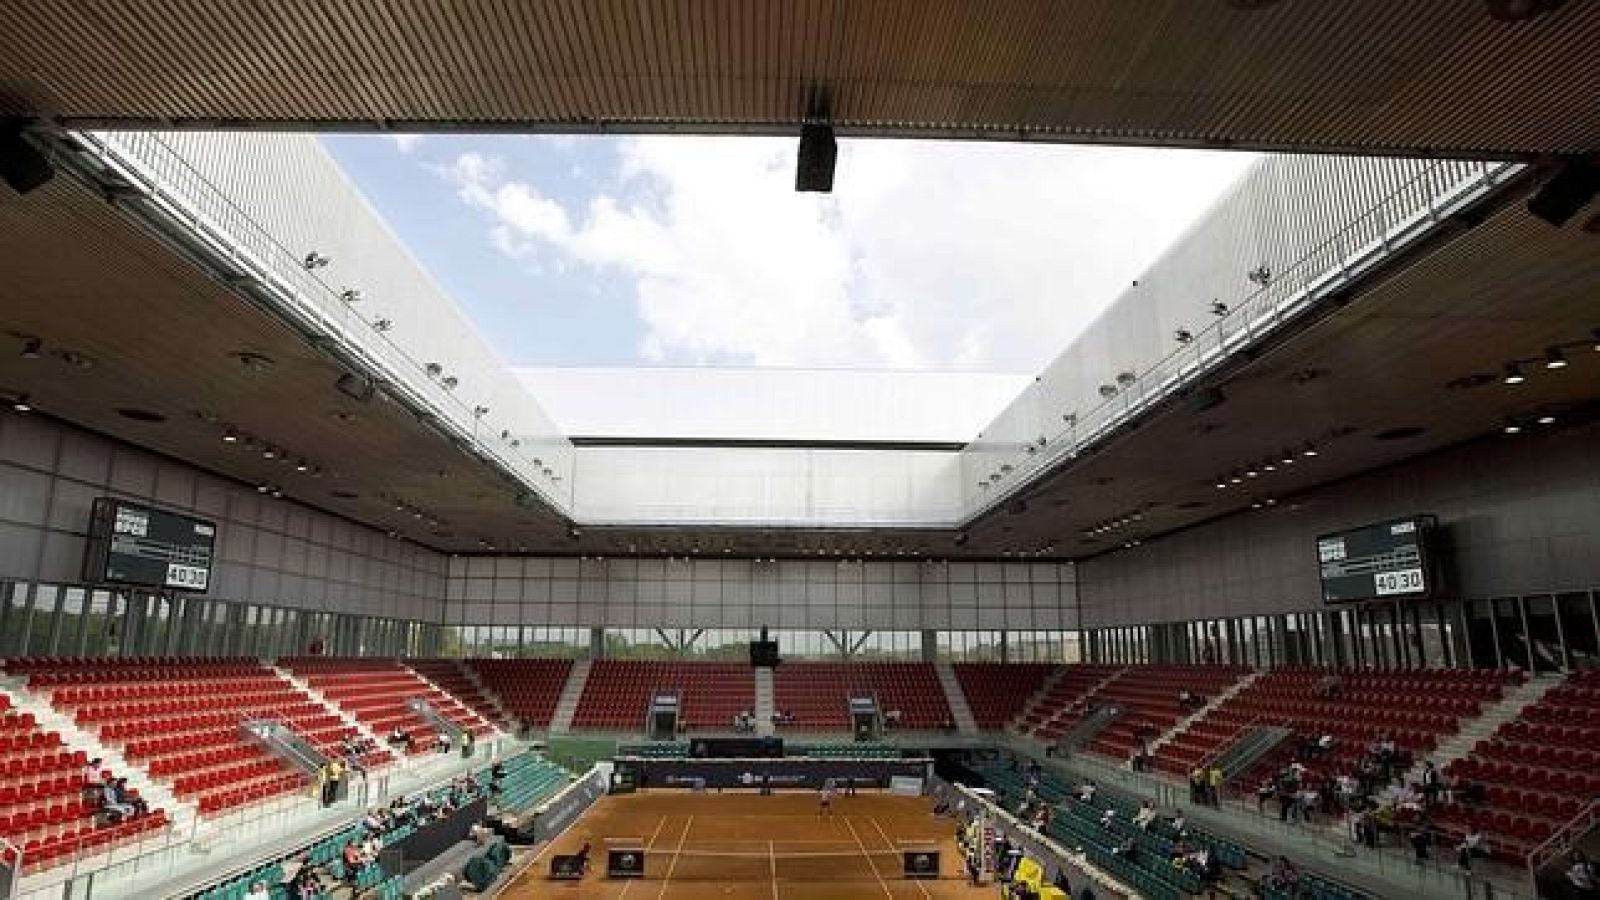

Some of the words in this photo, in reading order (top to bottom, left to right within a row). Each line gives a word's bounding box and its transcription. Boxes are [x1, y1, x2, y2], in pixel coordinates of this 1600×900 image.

[170, 567, 186, 582] 40
[189, 570, 205, 585] 30
[1377, 575, 1396, 590] 40
[1400, 572, 1420, 588] 30
